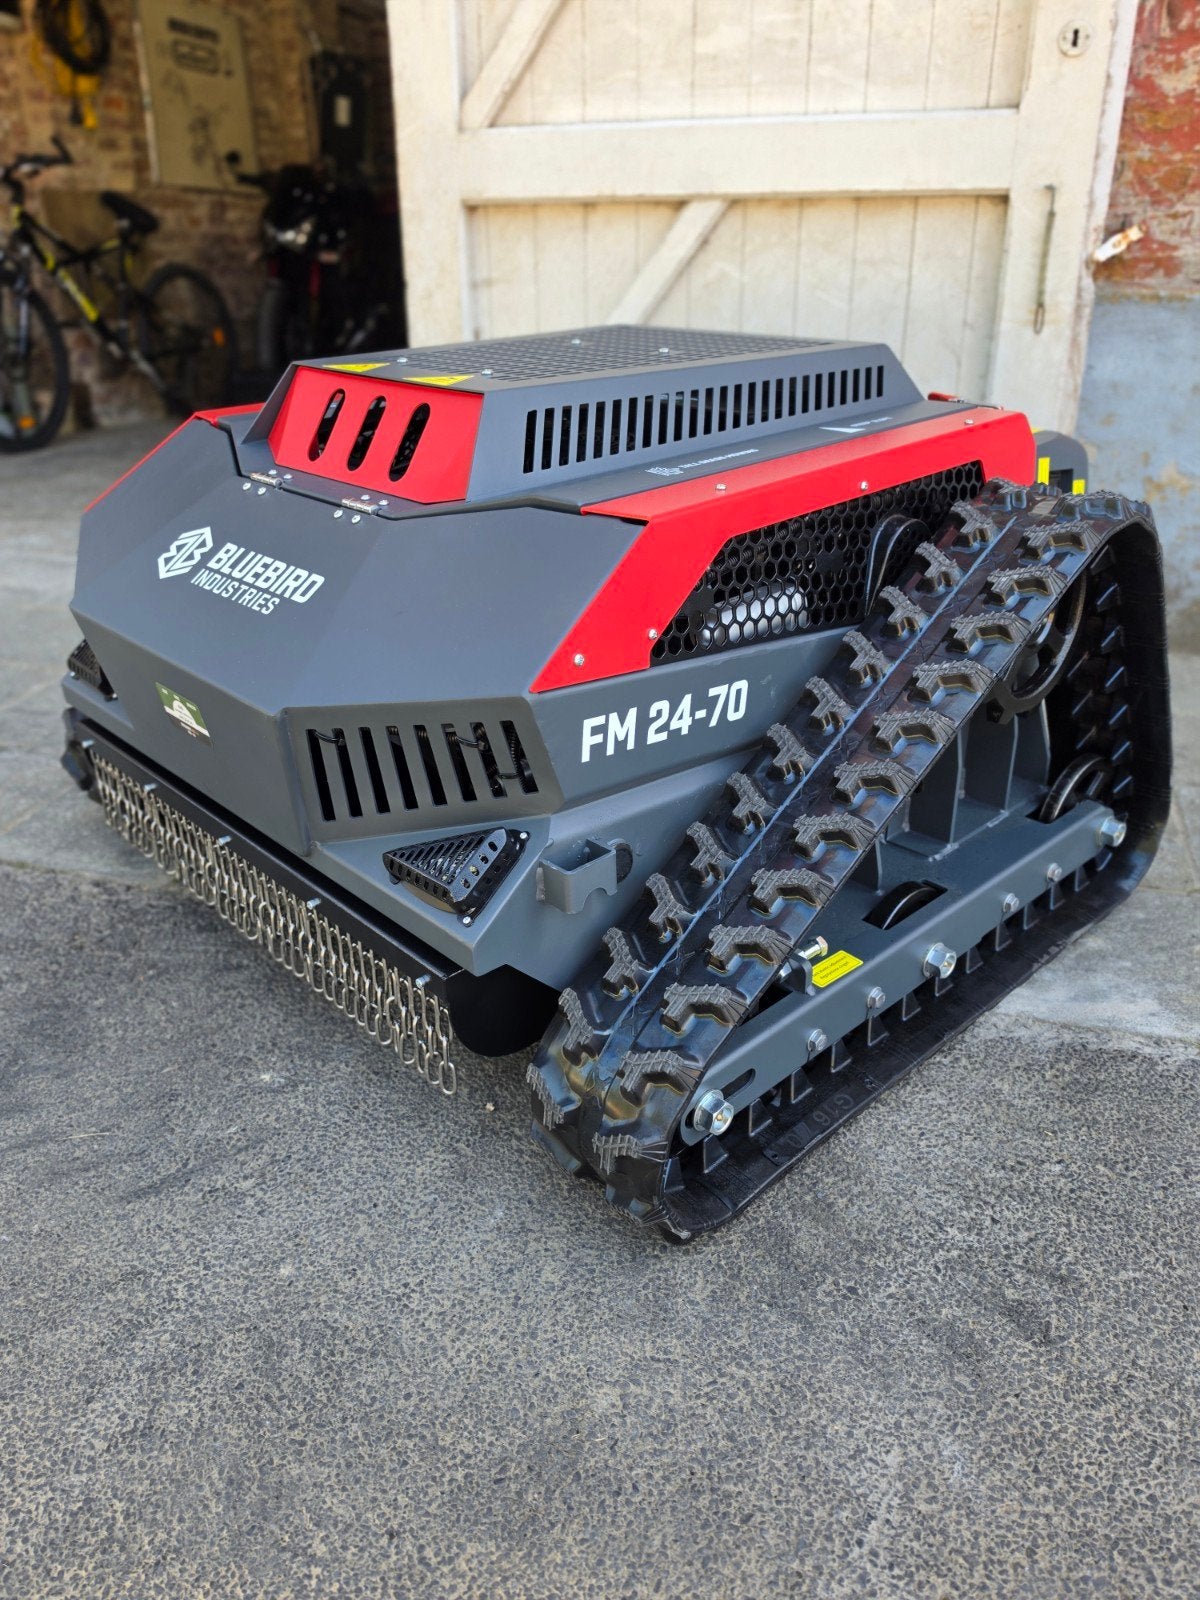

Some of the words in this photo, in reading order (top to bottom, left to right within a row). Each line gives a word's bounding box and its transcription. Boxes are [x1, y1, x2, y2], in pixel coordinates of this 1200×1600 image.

[190, 568, 280, 615] INDUSTRIES
[206, 542, 325, 604] BLUEBIRD
[581, 706, 637, 763] FM
[646, 679, 749, 745] 24-70
